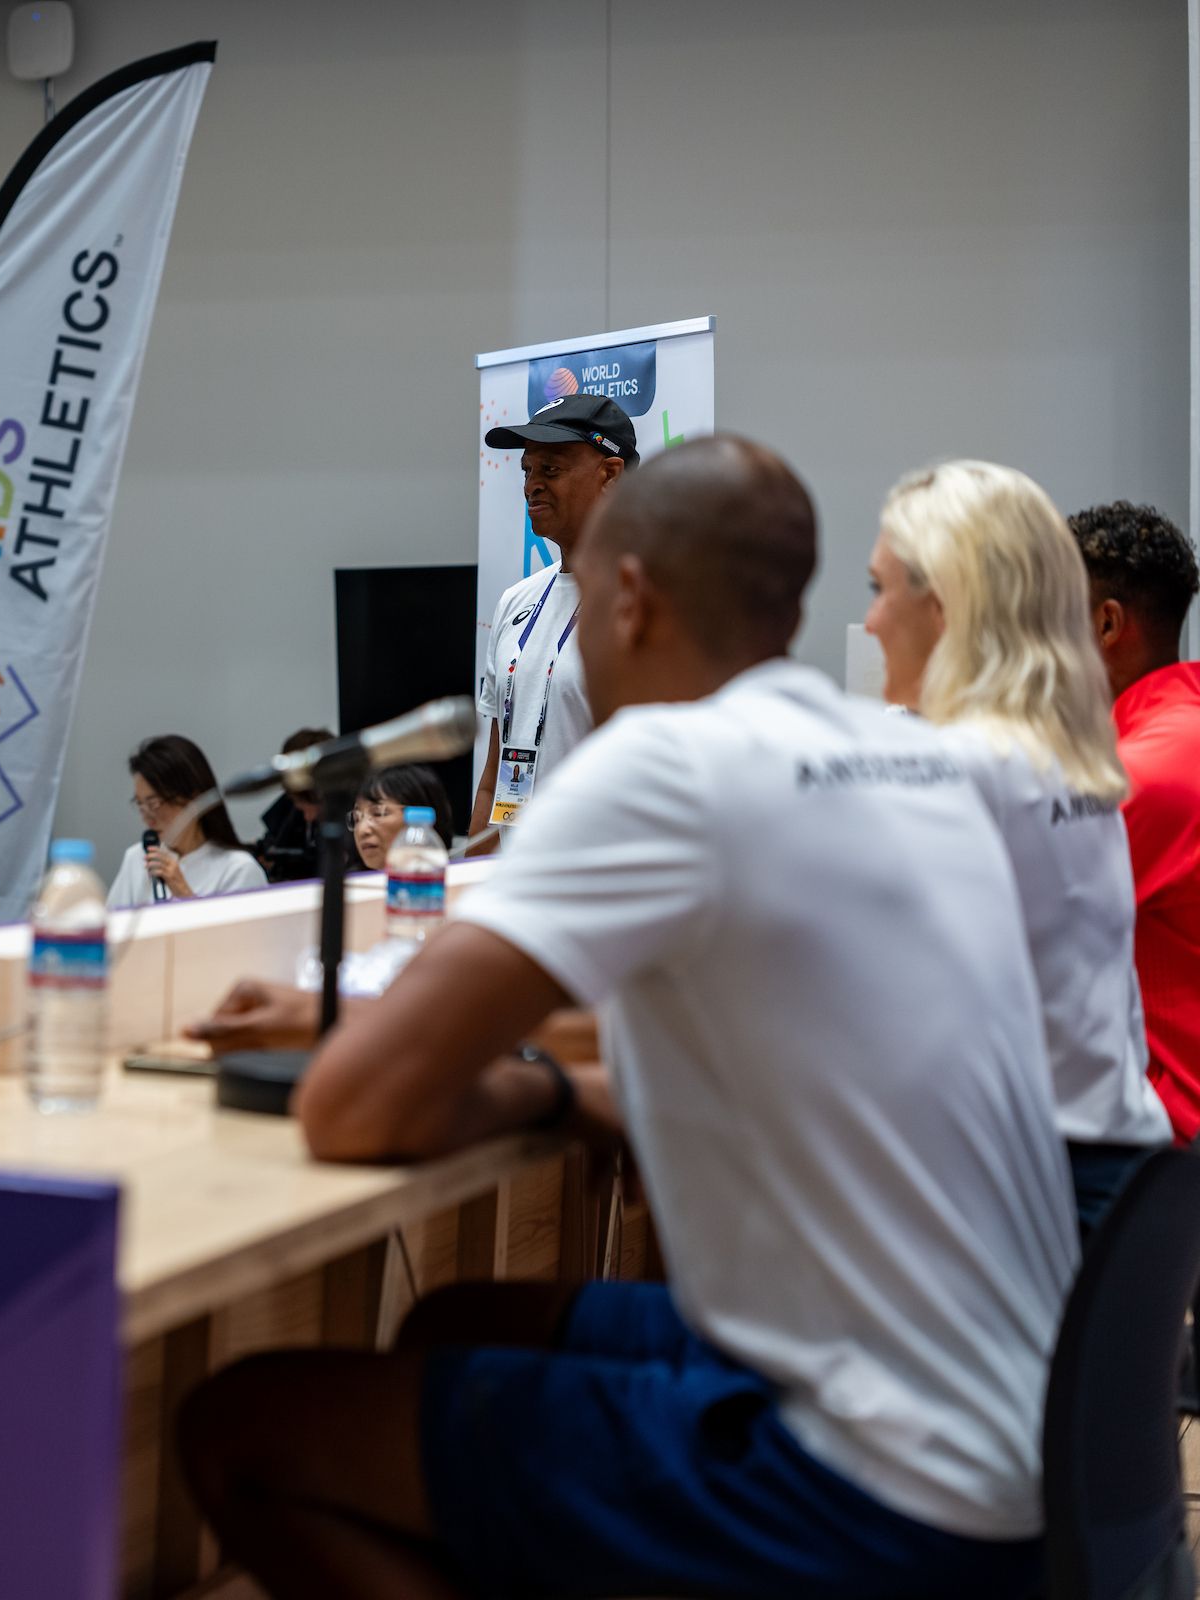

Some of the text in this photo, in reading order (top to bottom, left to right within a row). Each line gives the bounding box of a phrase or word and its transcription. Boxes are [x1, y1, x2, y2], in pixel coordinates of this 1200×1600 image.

[581, 363, 620, 382] WORLD
[582, 378, 639, 398] ATHLETICS
[9, 249, 119, 602] ATHLETICS
